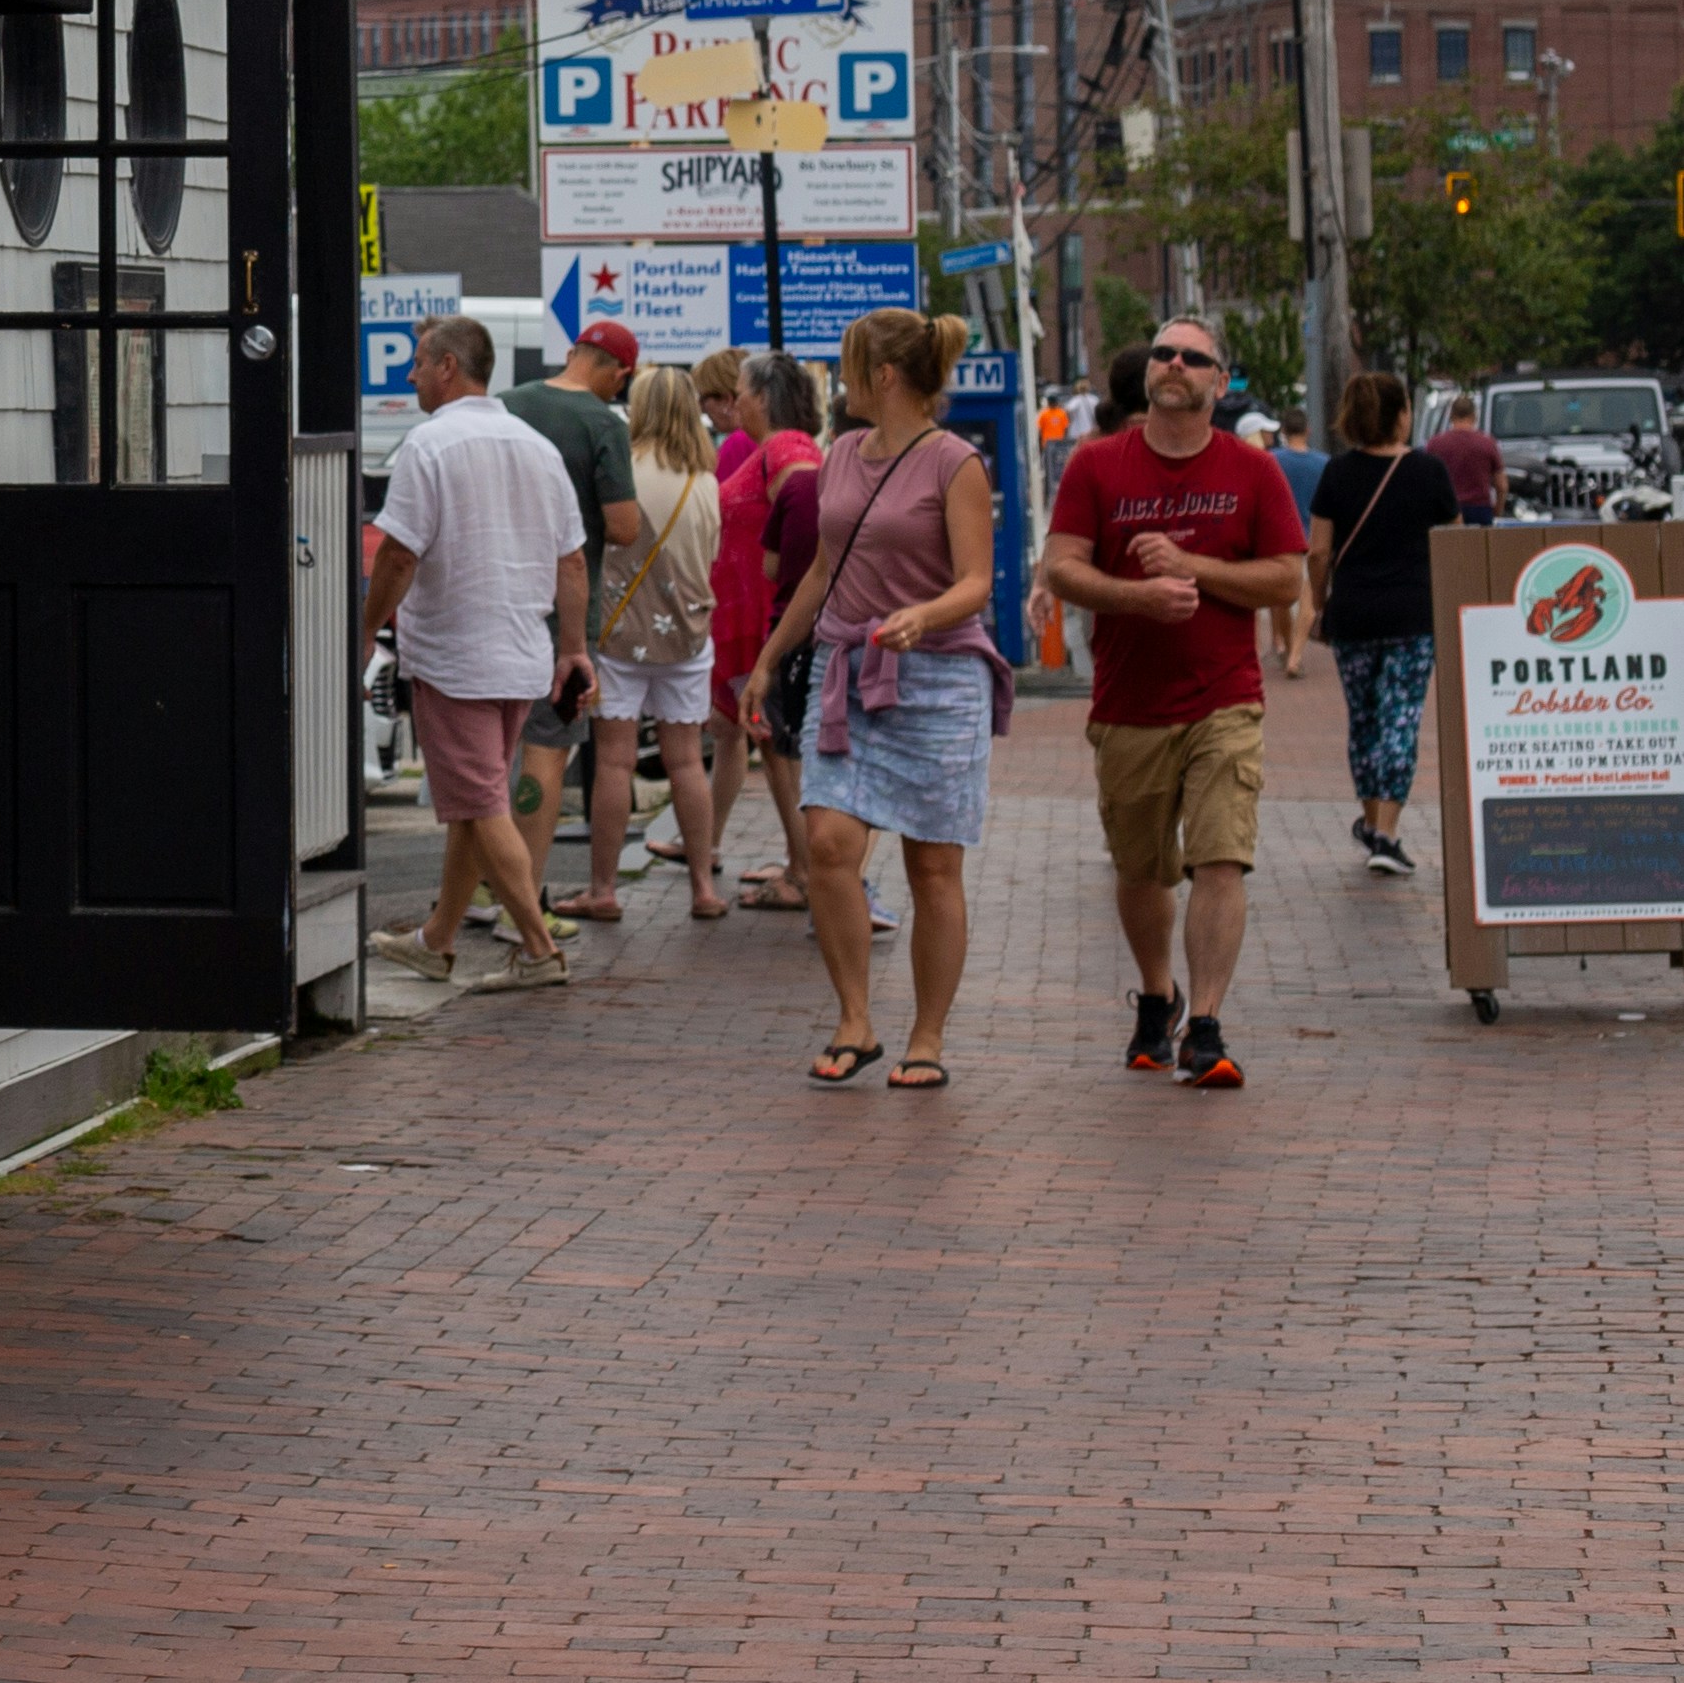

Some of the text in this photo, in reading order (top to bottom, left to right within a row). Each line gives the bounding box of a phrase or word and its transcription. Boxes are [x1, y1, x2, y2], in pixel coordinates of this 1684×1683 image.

[557, 66, 601, 117] P
[852, 60, 897, 112] P
[633, 259, 721, 276] Portland
[787, 249, 858, 263] Historical
[791, 263, 831, 276] Tours
[846, 262, 910, 276] Charters
[633, 281, 708, 297] Harbor
[383, 287, 459, 317] Parking
[633, 302, 683, 318] Fleet
[367, 331, 414, 386] P
[955, 363, 1004, 386] TM
[1176, 491, 1239, 517] JONES
[1490, 653, 1668, 685] PORTLAND
[1506, 685, 1655, 716] Lobster Co.
[1488, 735, 1678, 756] DECK SEATING TAKE OUT
[1476, 759, 1514, 773] OPEN
[1533, 757, 1555, 770] AM
[1587, 754, 1608, 768] PM
[1612, 752, 1659, 767] EVERY
